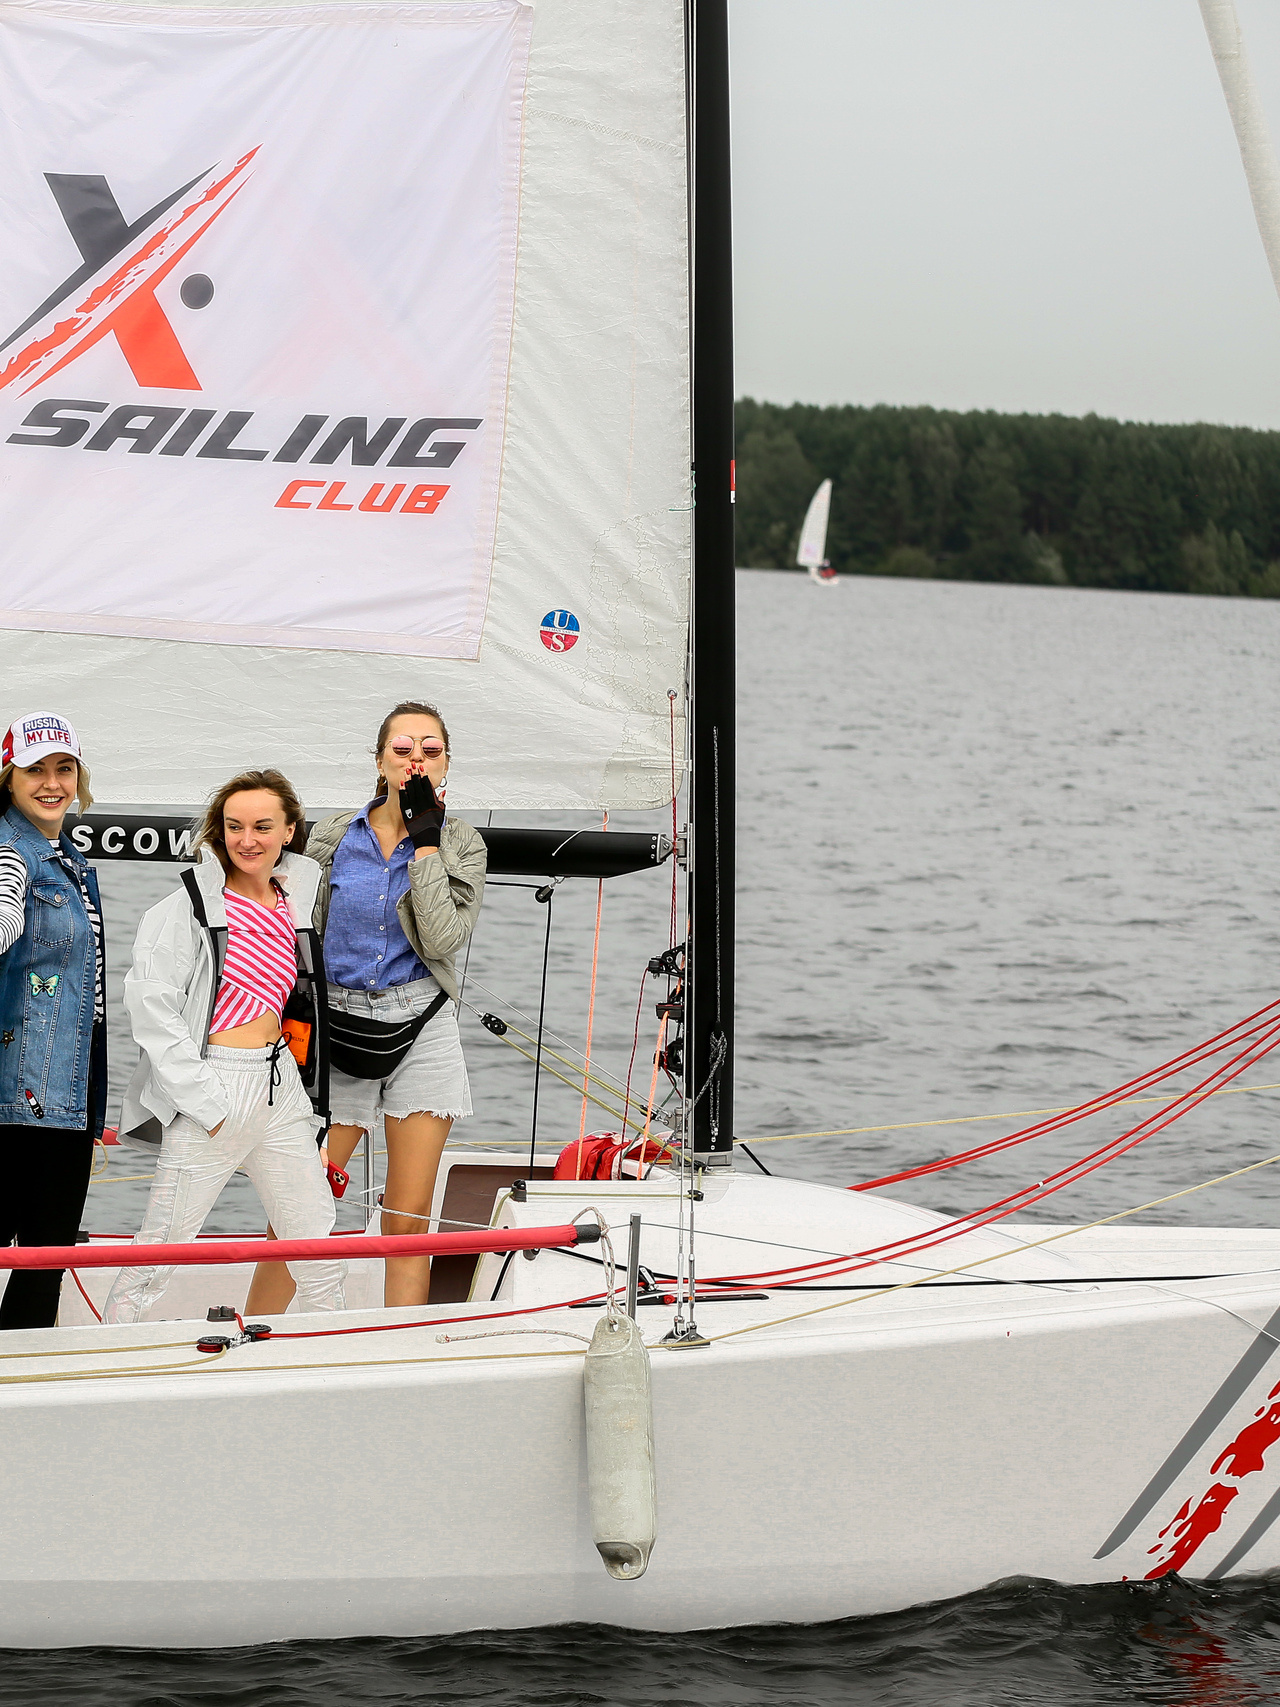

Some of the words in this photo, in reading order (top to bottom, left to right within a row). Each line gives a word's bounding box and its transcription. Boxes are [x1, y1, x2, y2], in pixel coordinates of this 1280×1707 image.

[5, 398, 483, 467] SAILING
[273, 479, 450, 514] CLUB
[25, 718, 58, 731] RUSSIA
[61, 721, 68, 731] IS
[27, 730, 43, 744] MY
[47, 729, 70, 744] LIFE
[71, 824, 202, 857] SCOW
